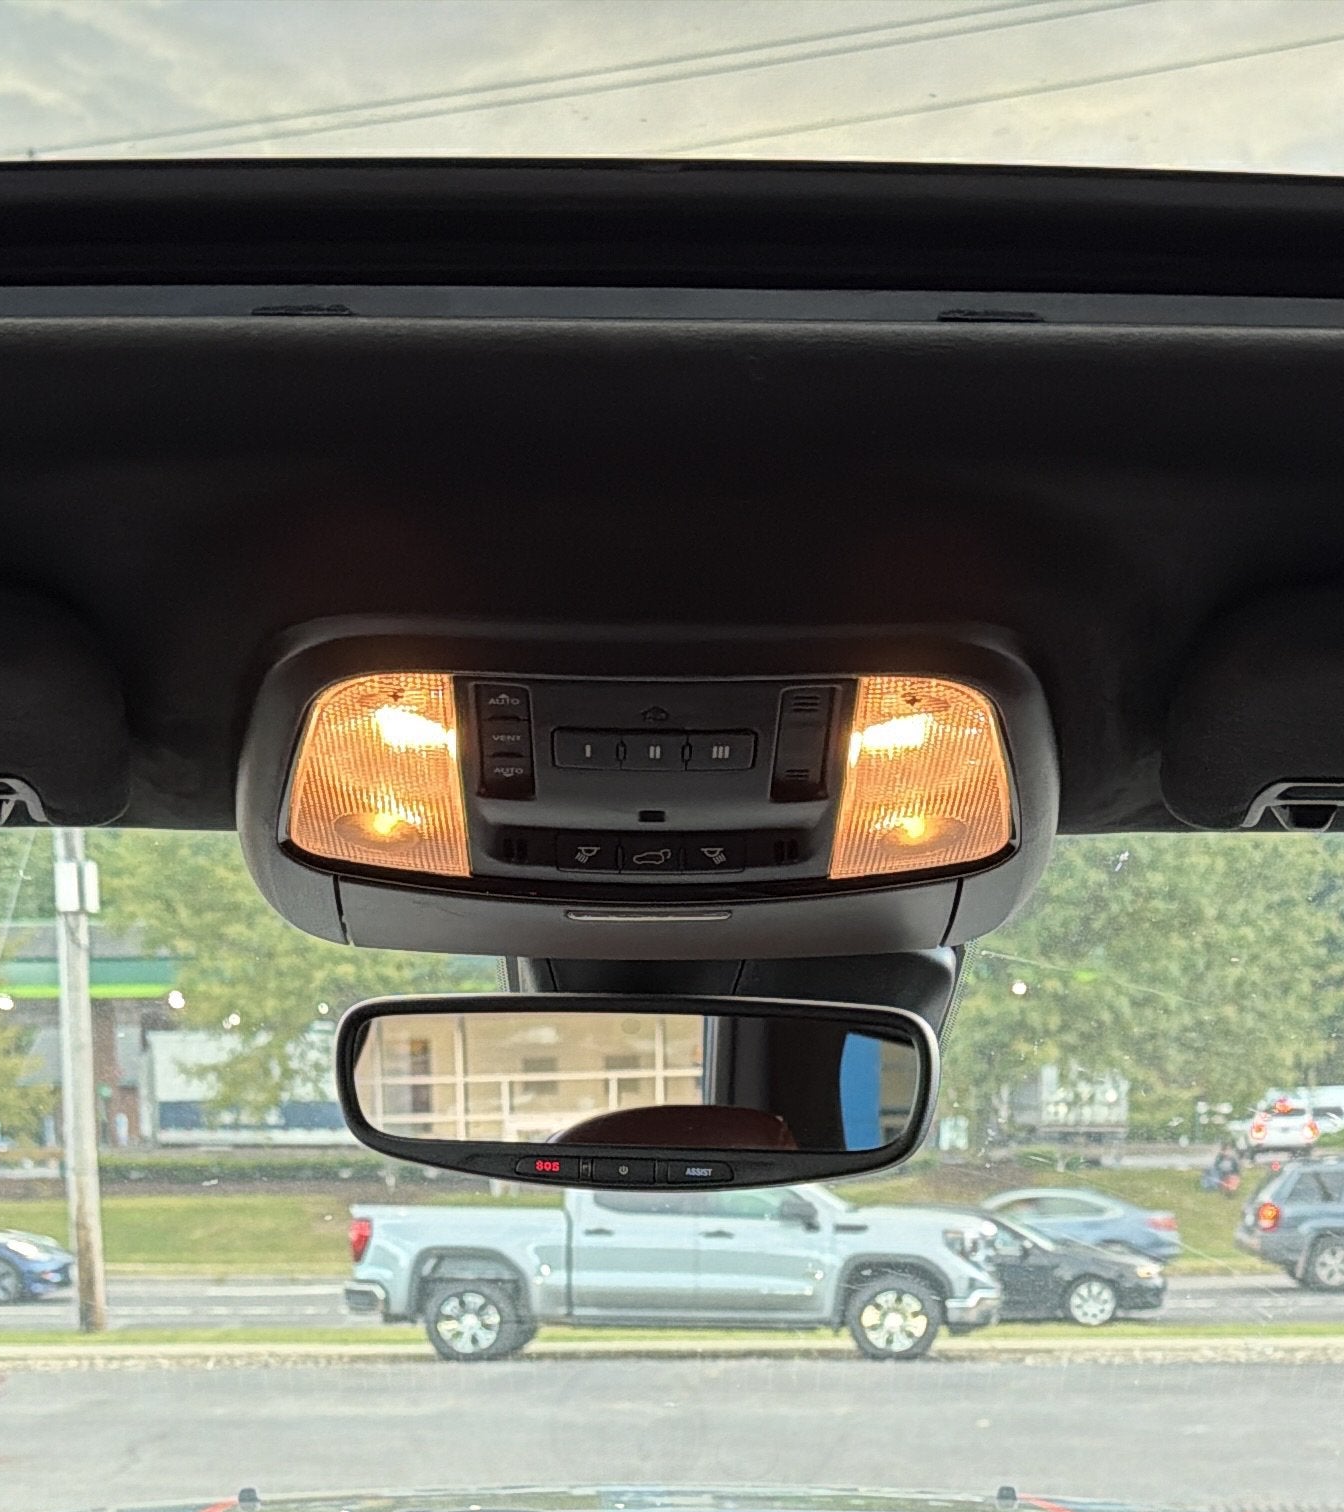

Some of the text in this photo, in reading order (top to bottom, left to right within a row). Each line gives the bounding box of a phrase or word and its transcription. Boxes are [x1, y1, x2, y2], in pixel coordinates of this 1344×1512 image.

[492, 734, 521, 742] VENT
[534, 1159, 560, 1172] SOS
[685, 1167, 713, 1177] ASSIST
